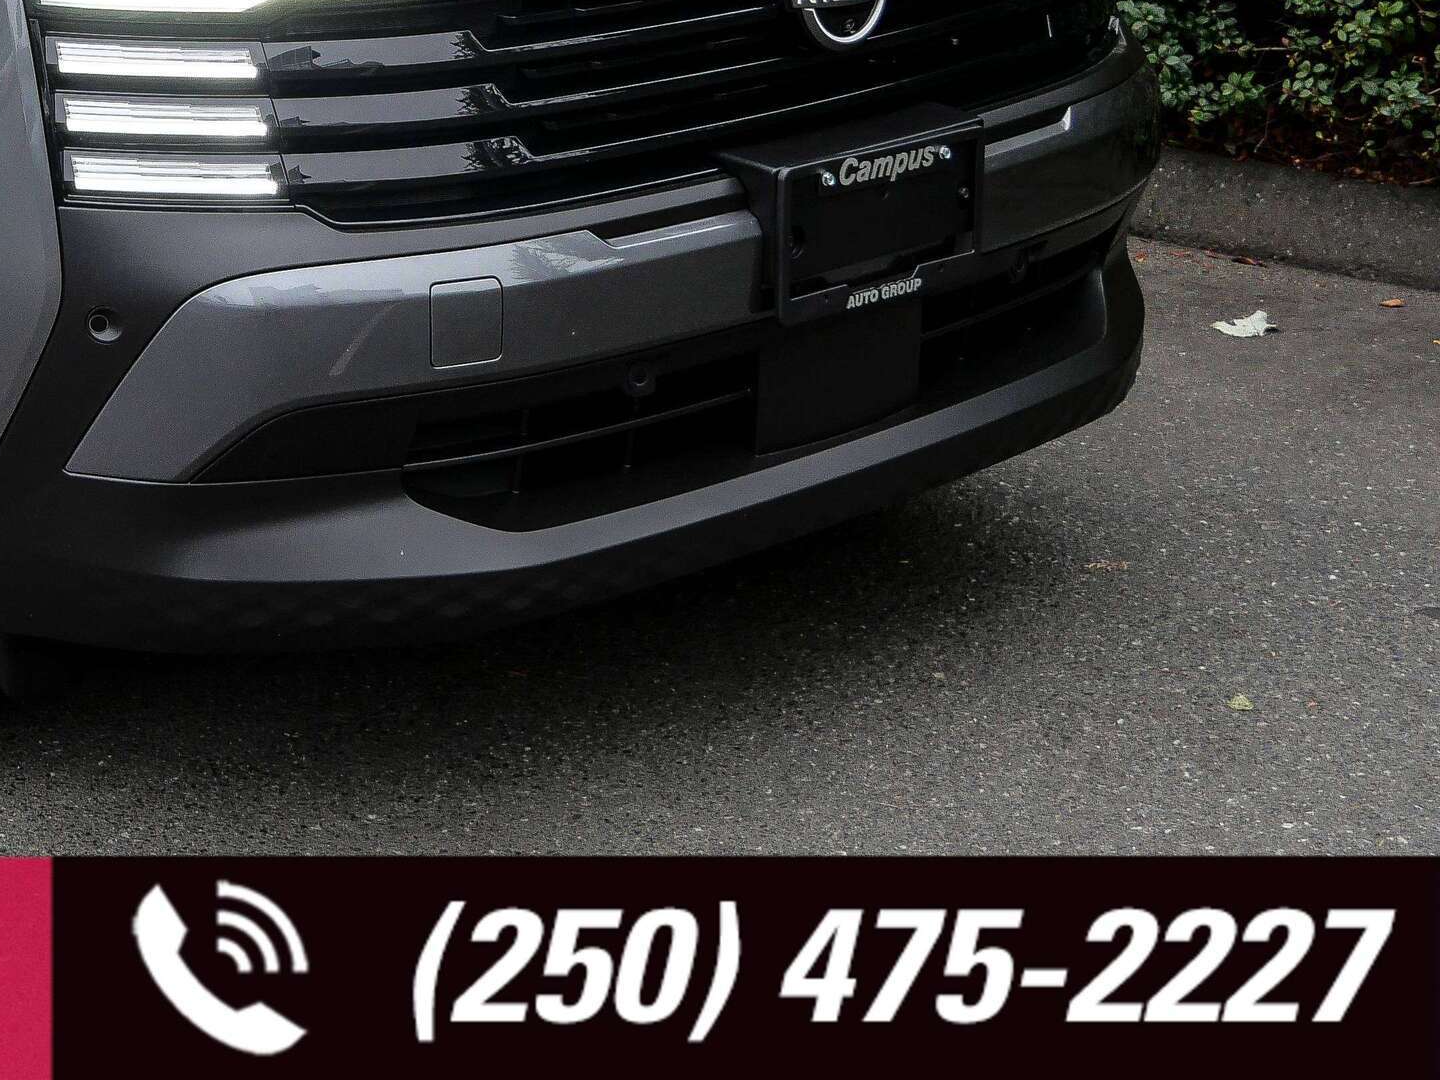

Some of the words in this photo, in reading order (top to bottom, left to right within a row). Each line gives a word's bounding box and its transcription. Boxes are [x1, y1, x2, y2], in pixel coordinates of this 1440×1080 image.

[838, 145, 937, 186] Campus
[846, 289, 879, 310] AUTO
[881, 277, 923, 301] GROUP
